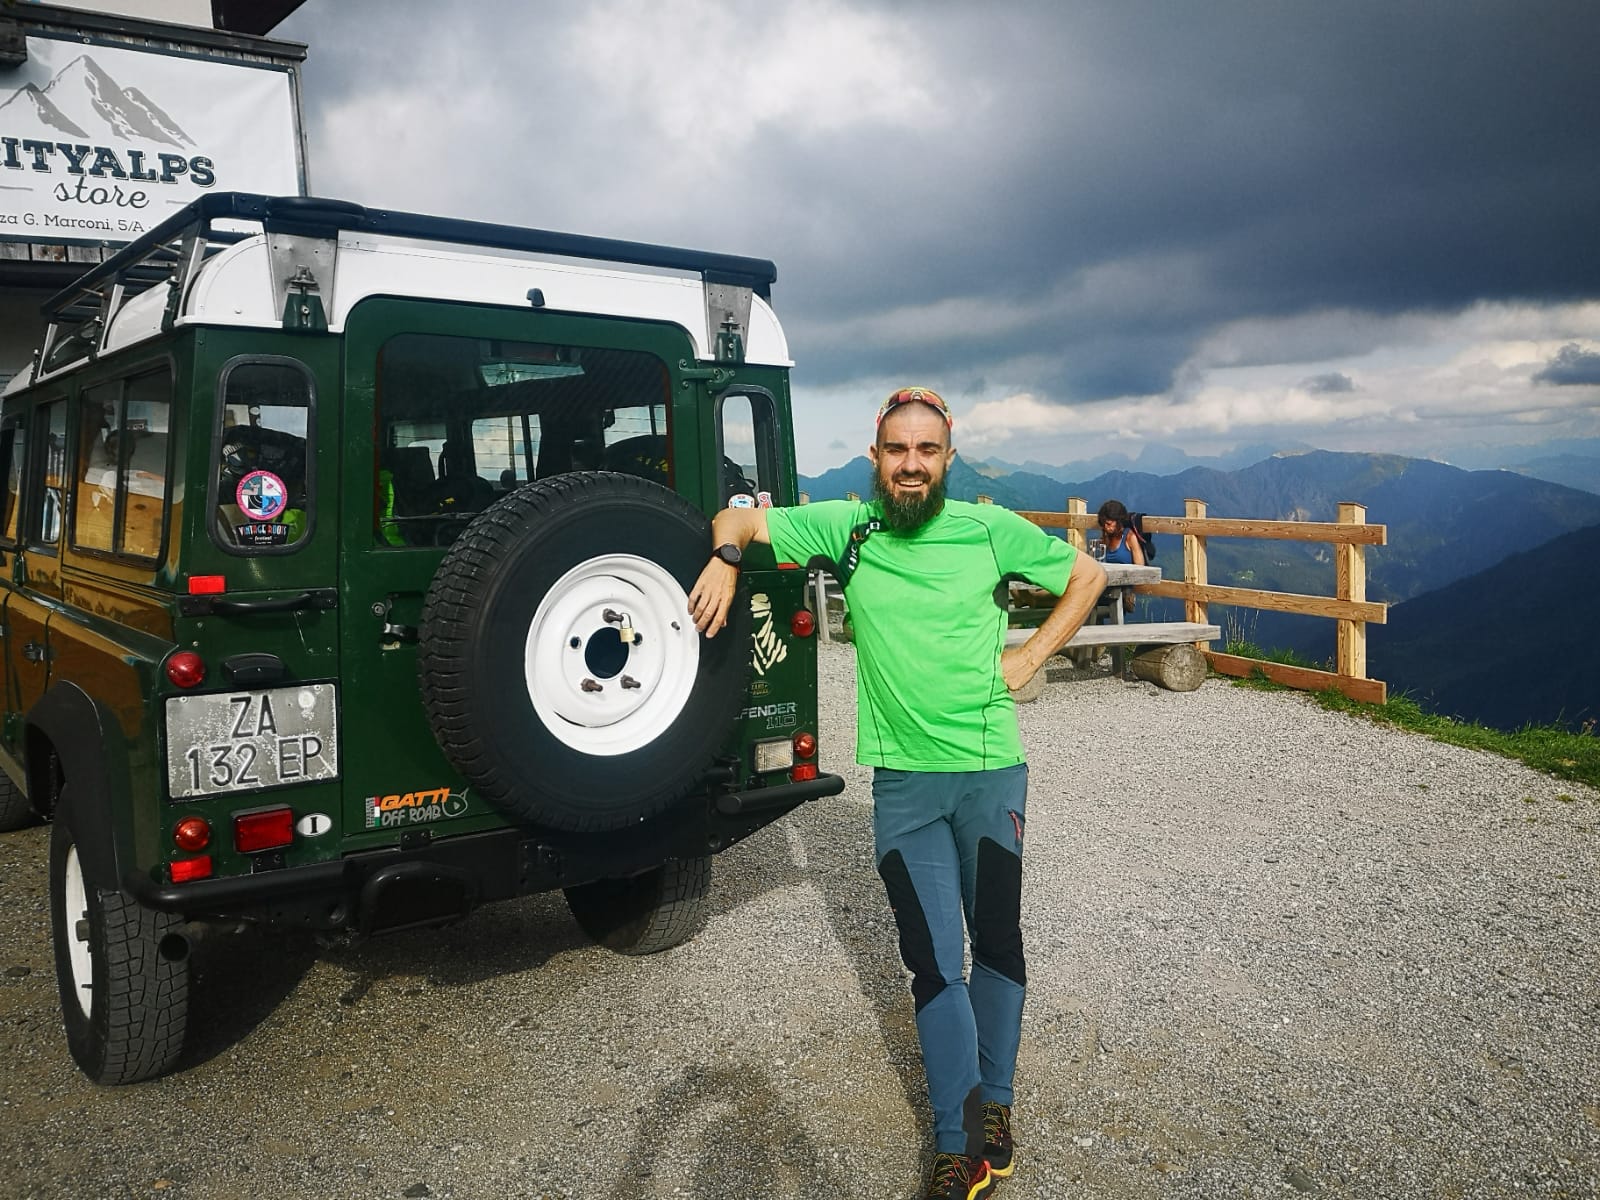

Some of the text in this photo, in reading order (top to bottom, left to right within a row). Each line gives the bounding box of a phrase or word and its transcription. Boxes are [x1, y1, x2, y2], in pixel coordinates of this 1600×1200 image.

[0, 136, 216, 188] ITYALPS
[53, 175, 150, 209] store
[23, 213, 39, 226] G.
[44, 214, 114, 231] Marconi,
[118, 219, 145, 232] 5/A
[230, 693, 278, 739] ZA
[766, 714, 797, 730] 110
[187, 735, 323, 790] 132 EP
[380, 787, 450, 811] GATTI
[309, 815, 319, 834] I
[381, 808, 406, 826] OFF
[409, 804, 441, 822] ROAD
